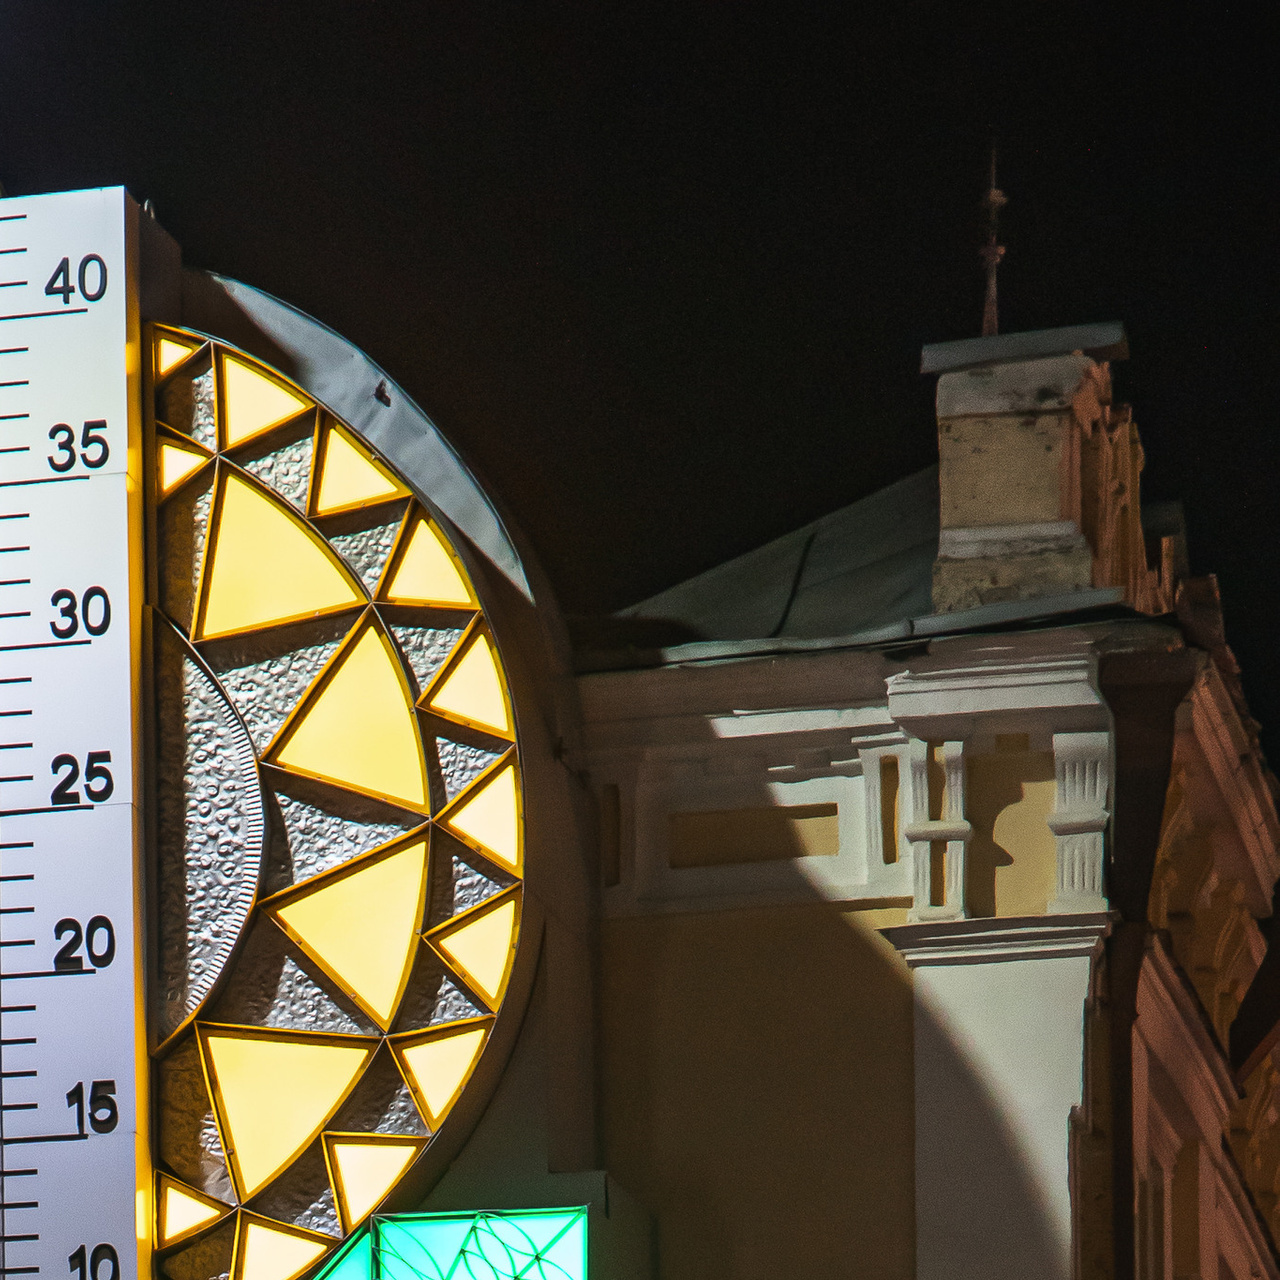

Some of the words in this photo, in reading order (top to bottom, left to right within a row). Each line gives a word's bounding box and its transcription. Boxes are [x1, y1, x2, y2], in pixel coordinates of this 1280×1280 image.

[45, 254, 108, 305] 40
[47, 419, 109, 472] 35
[50, 586, 111, 638] 30
[51, 750, 113, 804] 25
[54, 916, 116, 969] 20
[67, 1080, 118, 1136] 15
